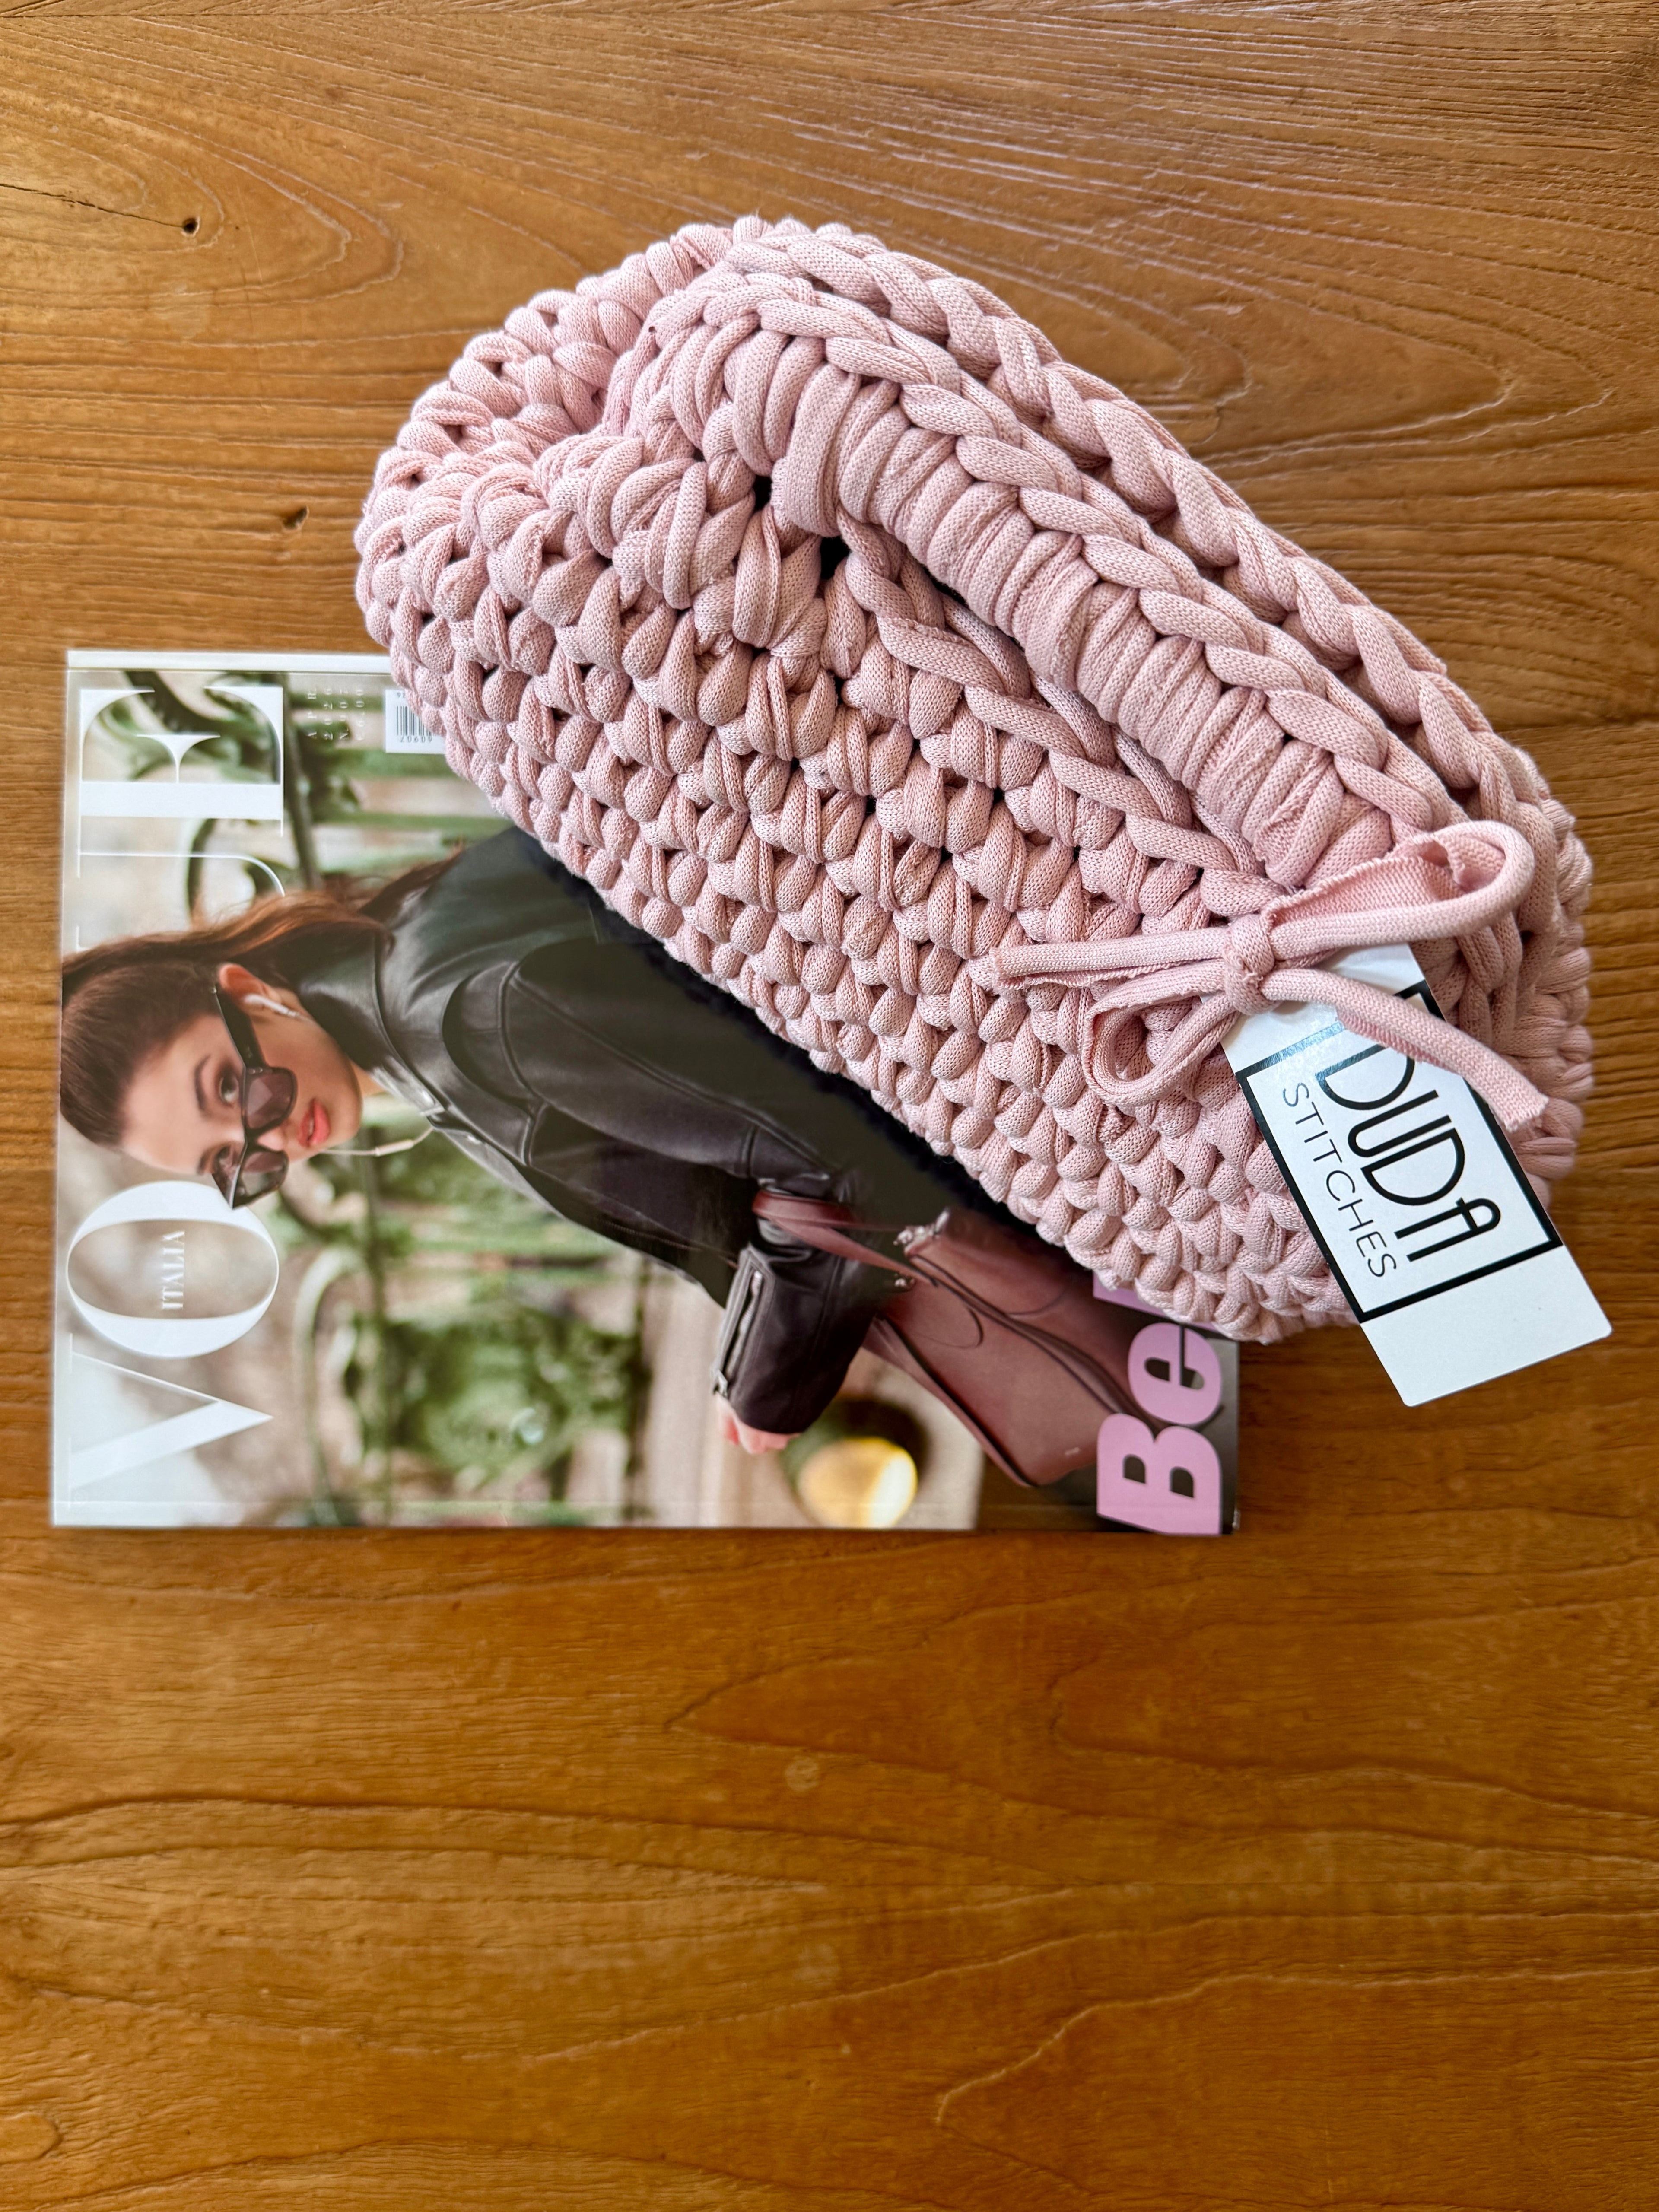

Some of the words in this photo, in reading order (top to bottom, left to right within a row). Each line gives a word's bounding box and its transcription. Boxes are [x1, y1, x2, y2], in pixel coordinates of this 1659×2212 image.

[66, 686, 285, 1509] VOE
[1283, 1081, 1397, 1278] STITCHES
[1315, 1043, 1501, 1262] DUDA
[161, 1230, 185, 1310] ITALIA
[1093, 1270, 1221, 1536] Be
